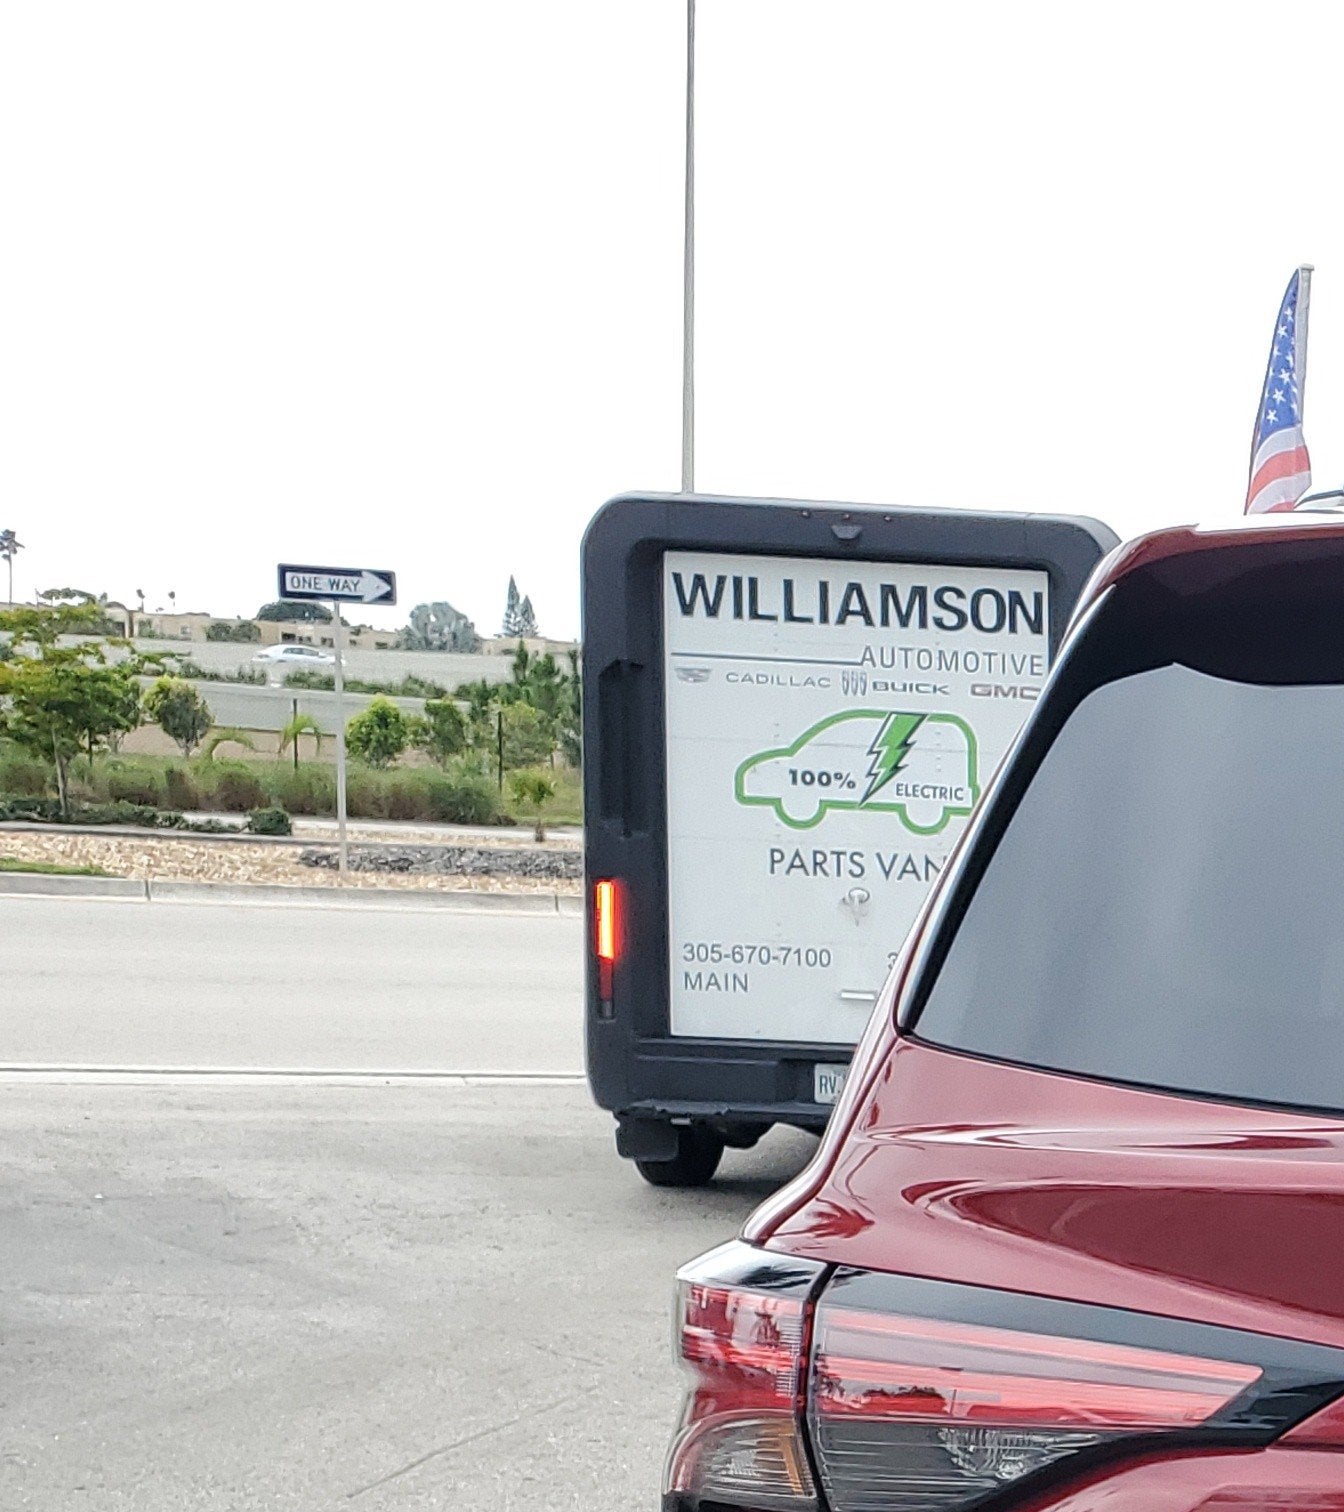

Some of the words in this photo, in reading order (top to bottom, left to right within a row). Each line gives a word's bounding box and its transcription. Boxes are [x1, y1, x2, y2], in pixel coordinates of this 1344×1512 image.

[290, 576, 322, 590] ONE
[328, 578, 360, 592] WAY
[671, 571, 1045, 636] WILLIAMSON
[860, 645, 1044, 677] AUTOMOTIVE
[725, 671, 831, 688] CADILLAC
[872, 680, 950, 696] BUICK
[970, 683, 1041, 700] GMC
[788, 767, 857, 791] 100%
[895, 782, 965, 802] ELECTRIC
[769, 847, 866, 878] PARTS
[875, 851, 948, 882] VAN
[682, 942, 832, 969] 305-670-7100
[684, 971, 749, 993] MAIN
